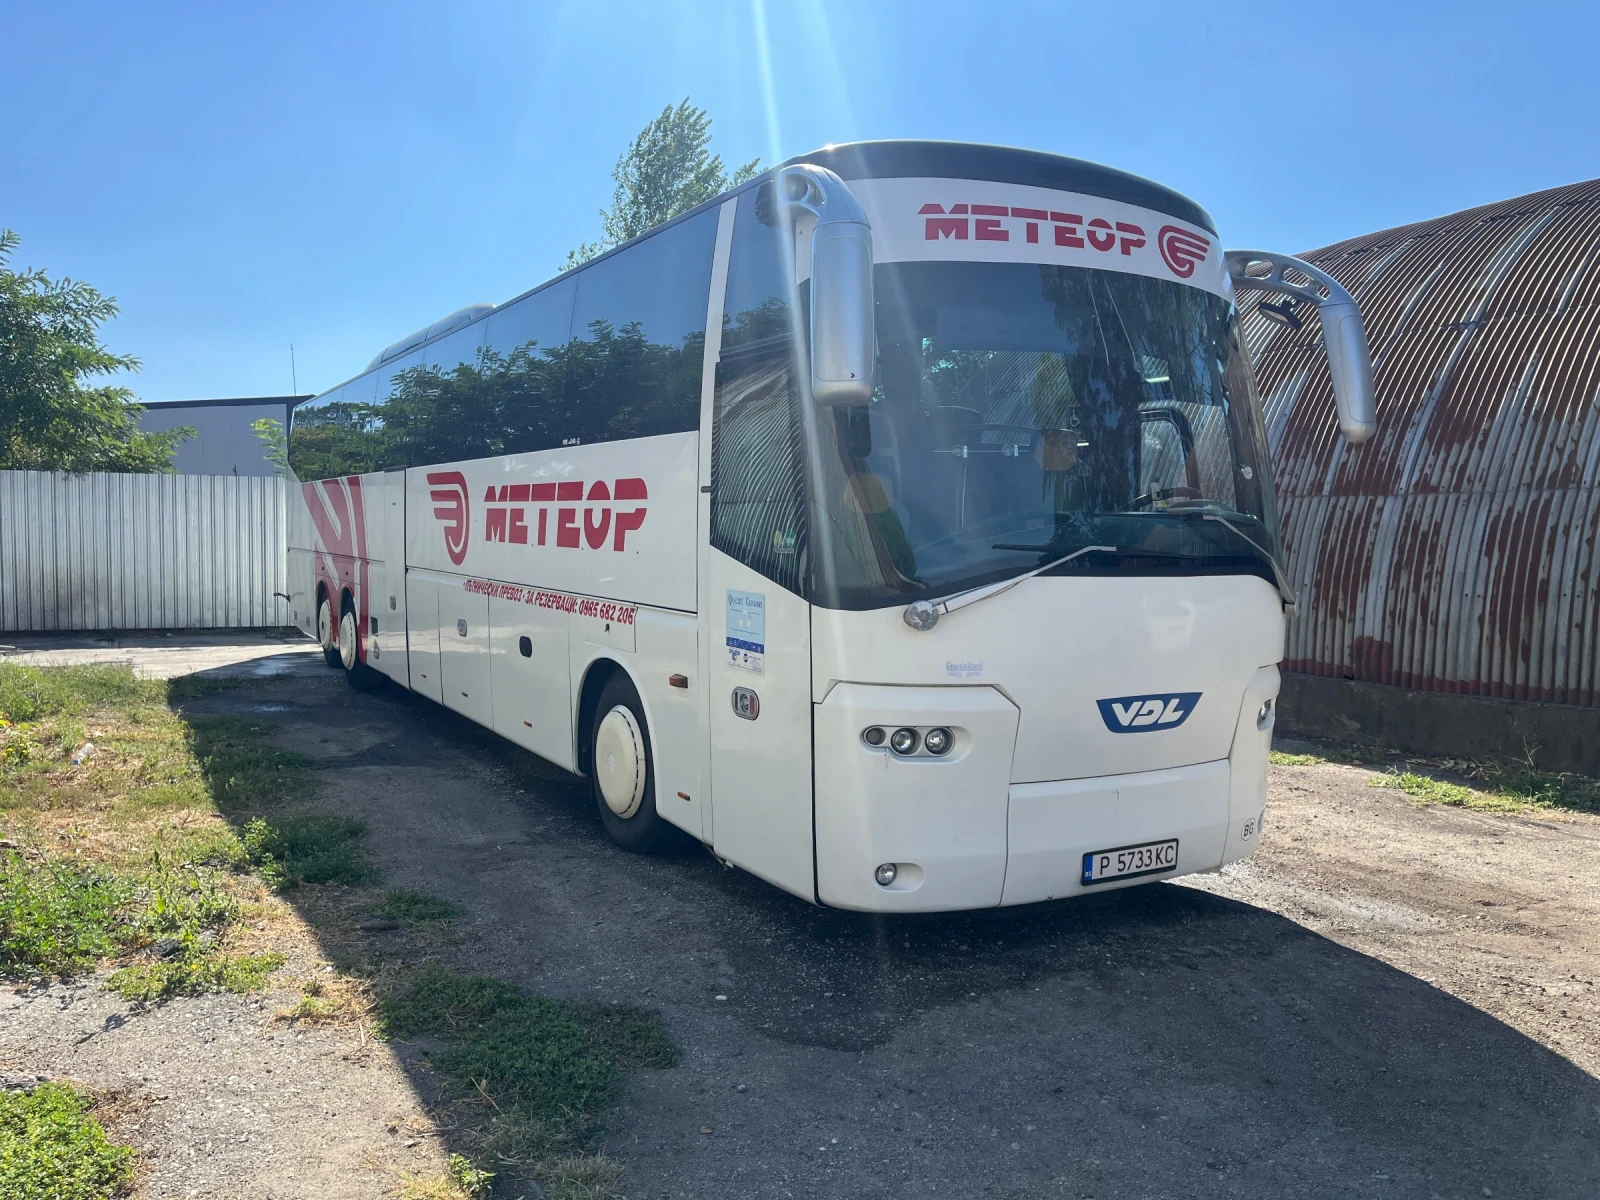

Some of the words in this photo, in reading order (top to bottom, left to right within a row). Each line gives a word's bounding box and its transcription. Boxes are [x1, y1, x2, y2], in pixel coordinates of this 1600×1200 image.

[917, 203, 1146, 256] МЕТЕОР
[484, 477, 648, 552] МЕТЕОР
[499, 585, 523, 602] ПРЕВОЗ
[525, 590, 535, 605] ЗА
[578, 599, 599, 618] 0885
[600, 603, 616, 621] 682
[617, 606, 635, 625] 206
[1111, 698, 1185, 727] VDL
[1243, 822, 1255, 837] BG
